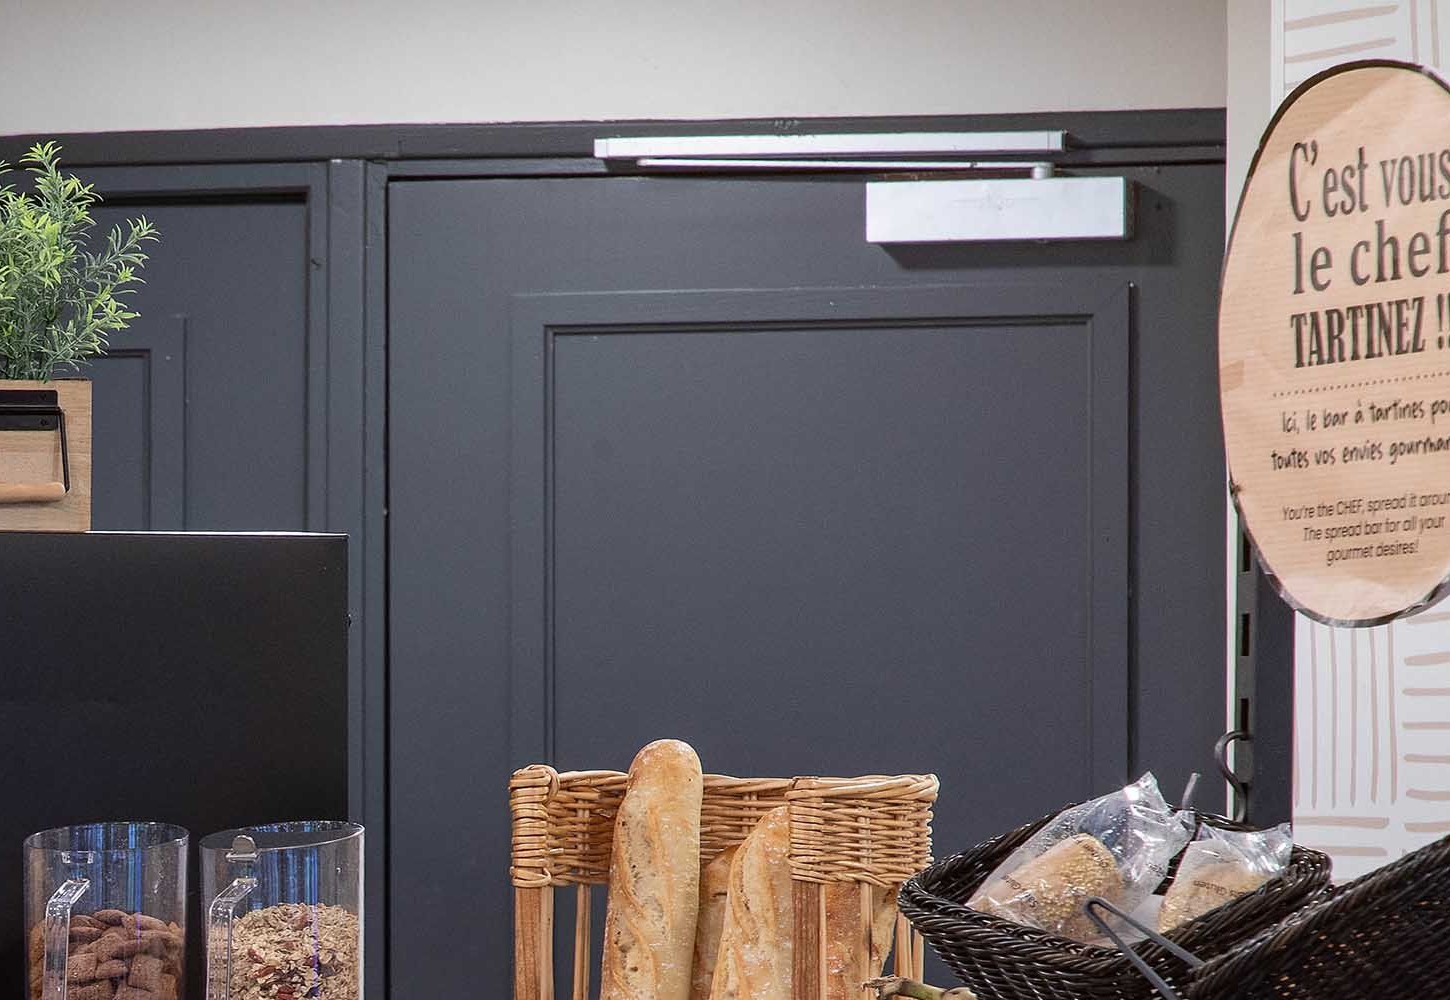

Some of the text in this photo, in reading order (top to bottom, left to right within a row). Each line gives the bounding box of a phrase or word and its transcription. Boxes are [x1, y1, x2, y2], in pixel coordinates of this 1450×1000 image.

[1288, 139, 1450, 222] C’est vous
[1292, 208, 1450, 295] le chef
[1290, 296, 1427, 369] TARTINEZ
[1282, 410, 1300, 434] Ici,
[1306, 409, 1318, 431] le
[1322, 408, 1349, 429] bar
[1354, 399, 1365, 424] à
[1369, 398, 1426, 424] tartines
[1271, 447, 1310, 471] toutes
[1315, 447, 1337, 465] vos
[1342, 440, 1384, 464] envies
[1316, 501, 1334, 518] the
[1336, 497, 1364, 515] CHEF,
[1367, 496, 1406, 516] spread
[1303, 515, 1446, 543] The spread bar for all your
[1325, 539, 1419, 567] gourmet desires!
